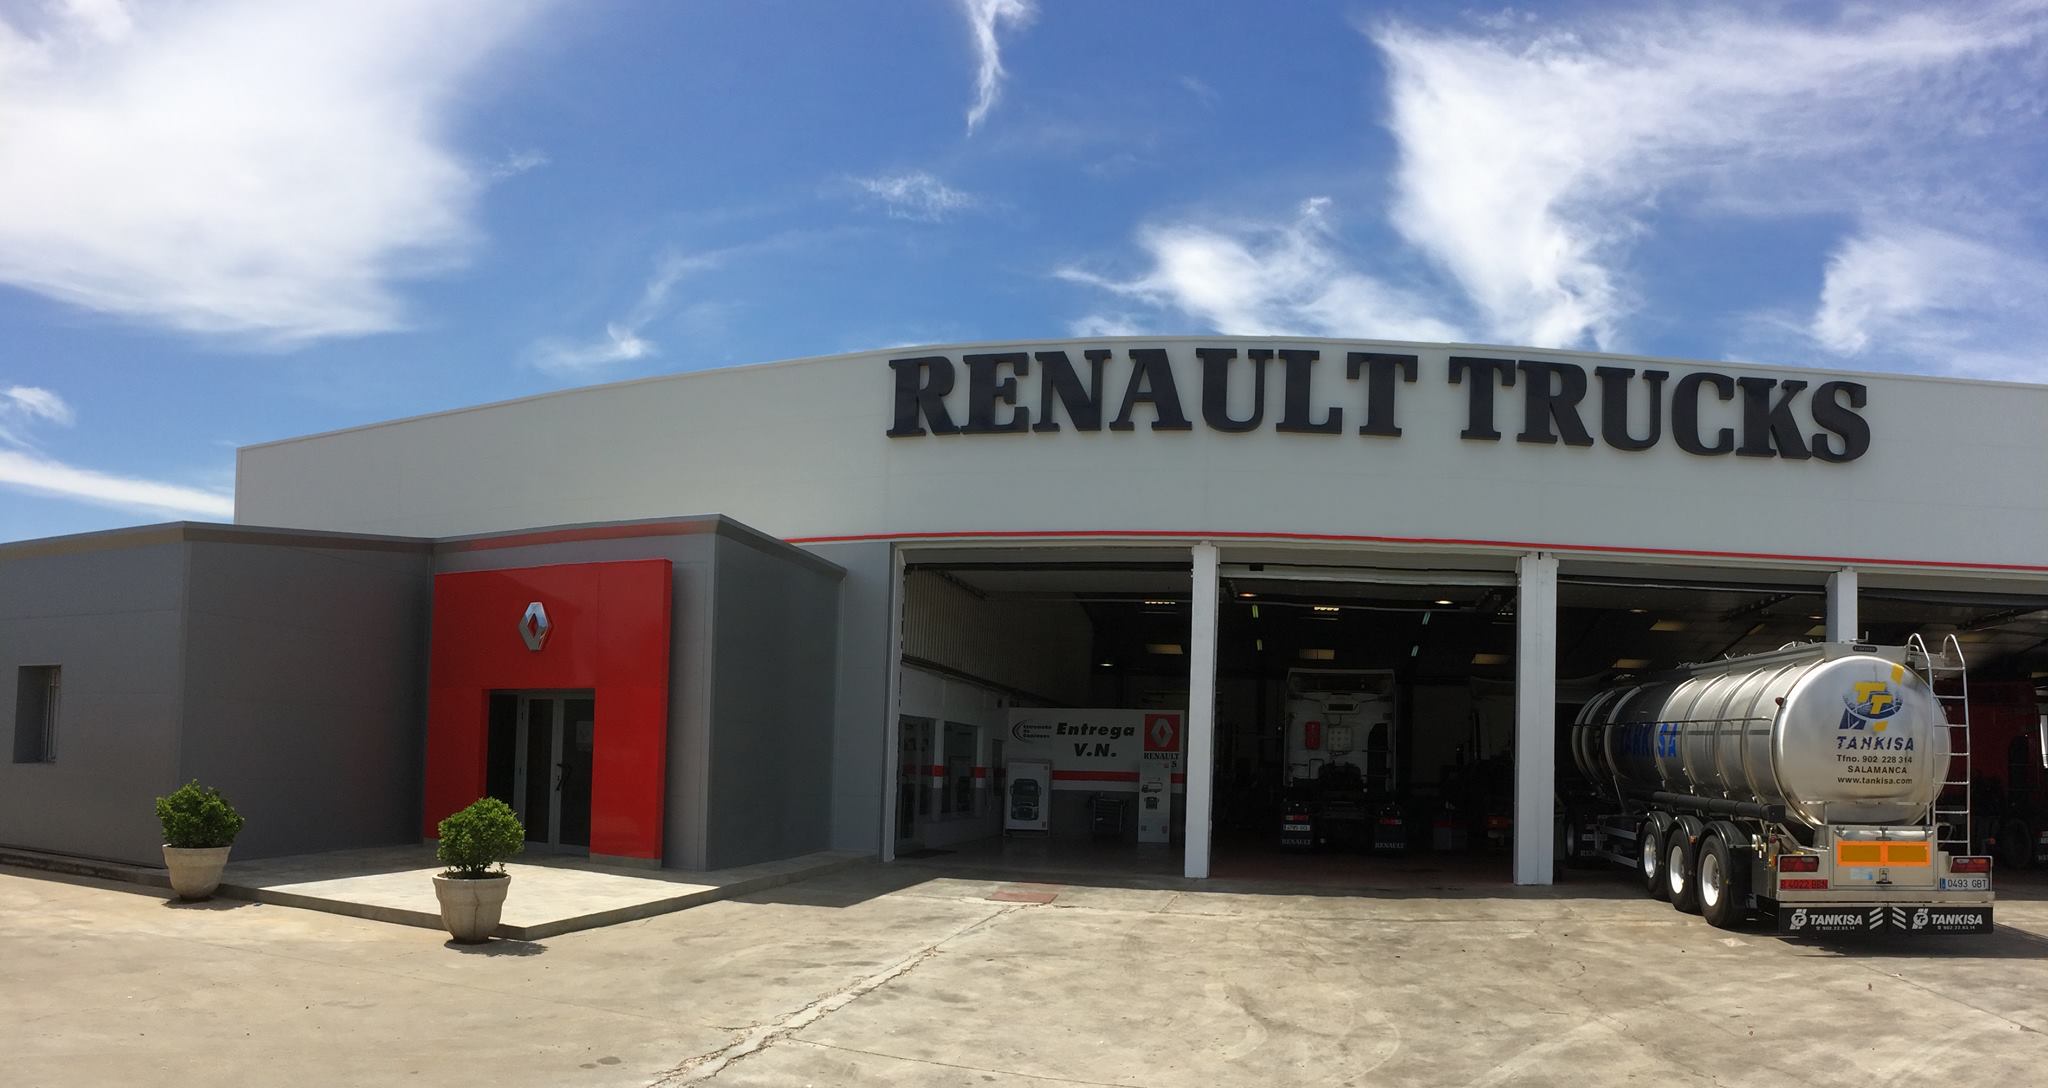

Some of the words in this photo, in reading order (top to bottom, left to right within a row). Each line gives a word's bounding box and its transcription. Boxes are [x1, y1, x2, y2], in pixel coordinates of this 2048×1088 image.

[887, 347, 1418, 437] RENAULT
[1448, 356, 1871, 463] TRUCKS
[1056, 722, 1135, 739] Entrega
[1837, 736, 1914, 751] TANKISA
[1074, 743, 1117, 757] V.N.
[1144, 752, 1180, 760] RENAULT
[1837, 755, 1860, 763] Tfno.
[1882, 756, 1896, 764] 228
[1847, 766, 1908, 774] SALAMANCA
[1837, 777, 1912, 785] www.tankisa.com
[1948, 879, 1968, 888] 0493
[1971, 879, 1987, 888] GBT
[1810, 914, 1863, 926] TANKISA
[1931, 914, 1983, 925] TANKISA
